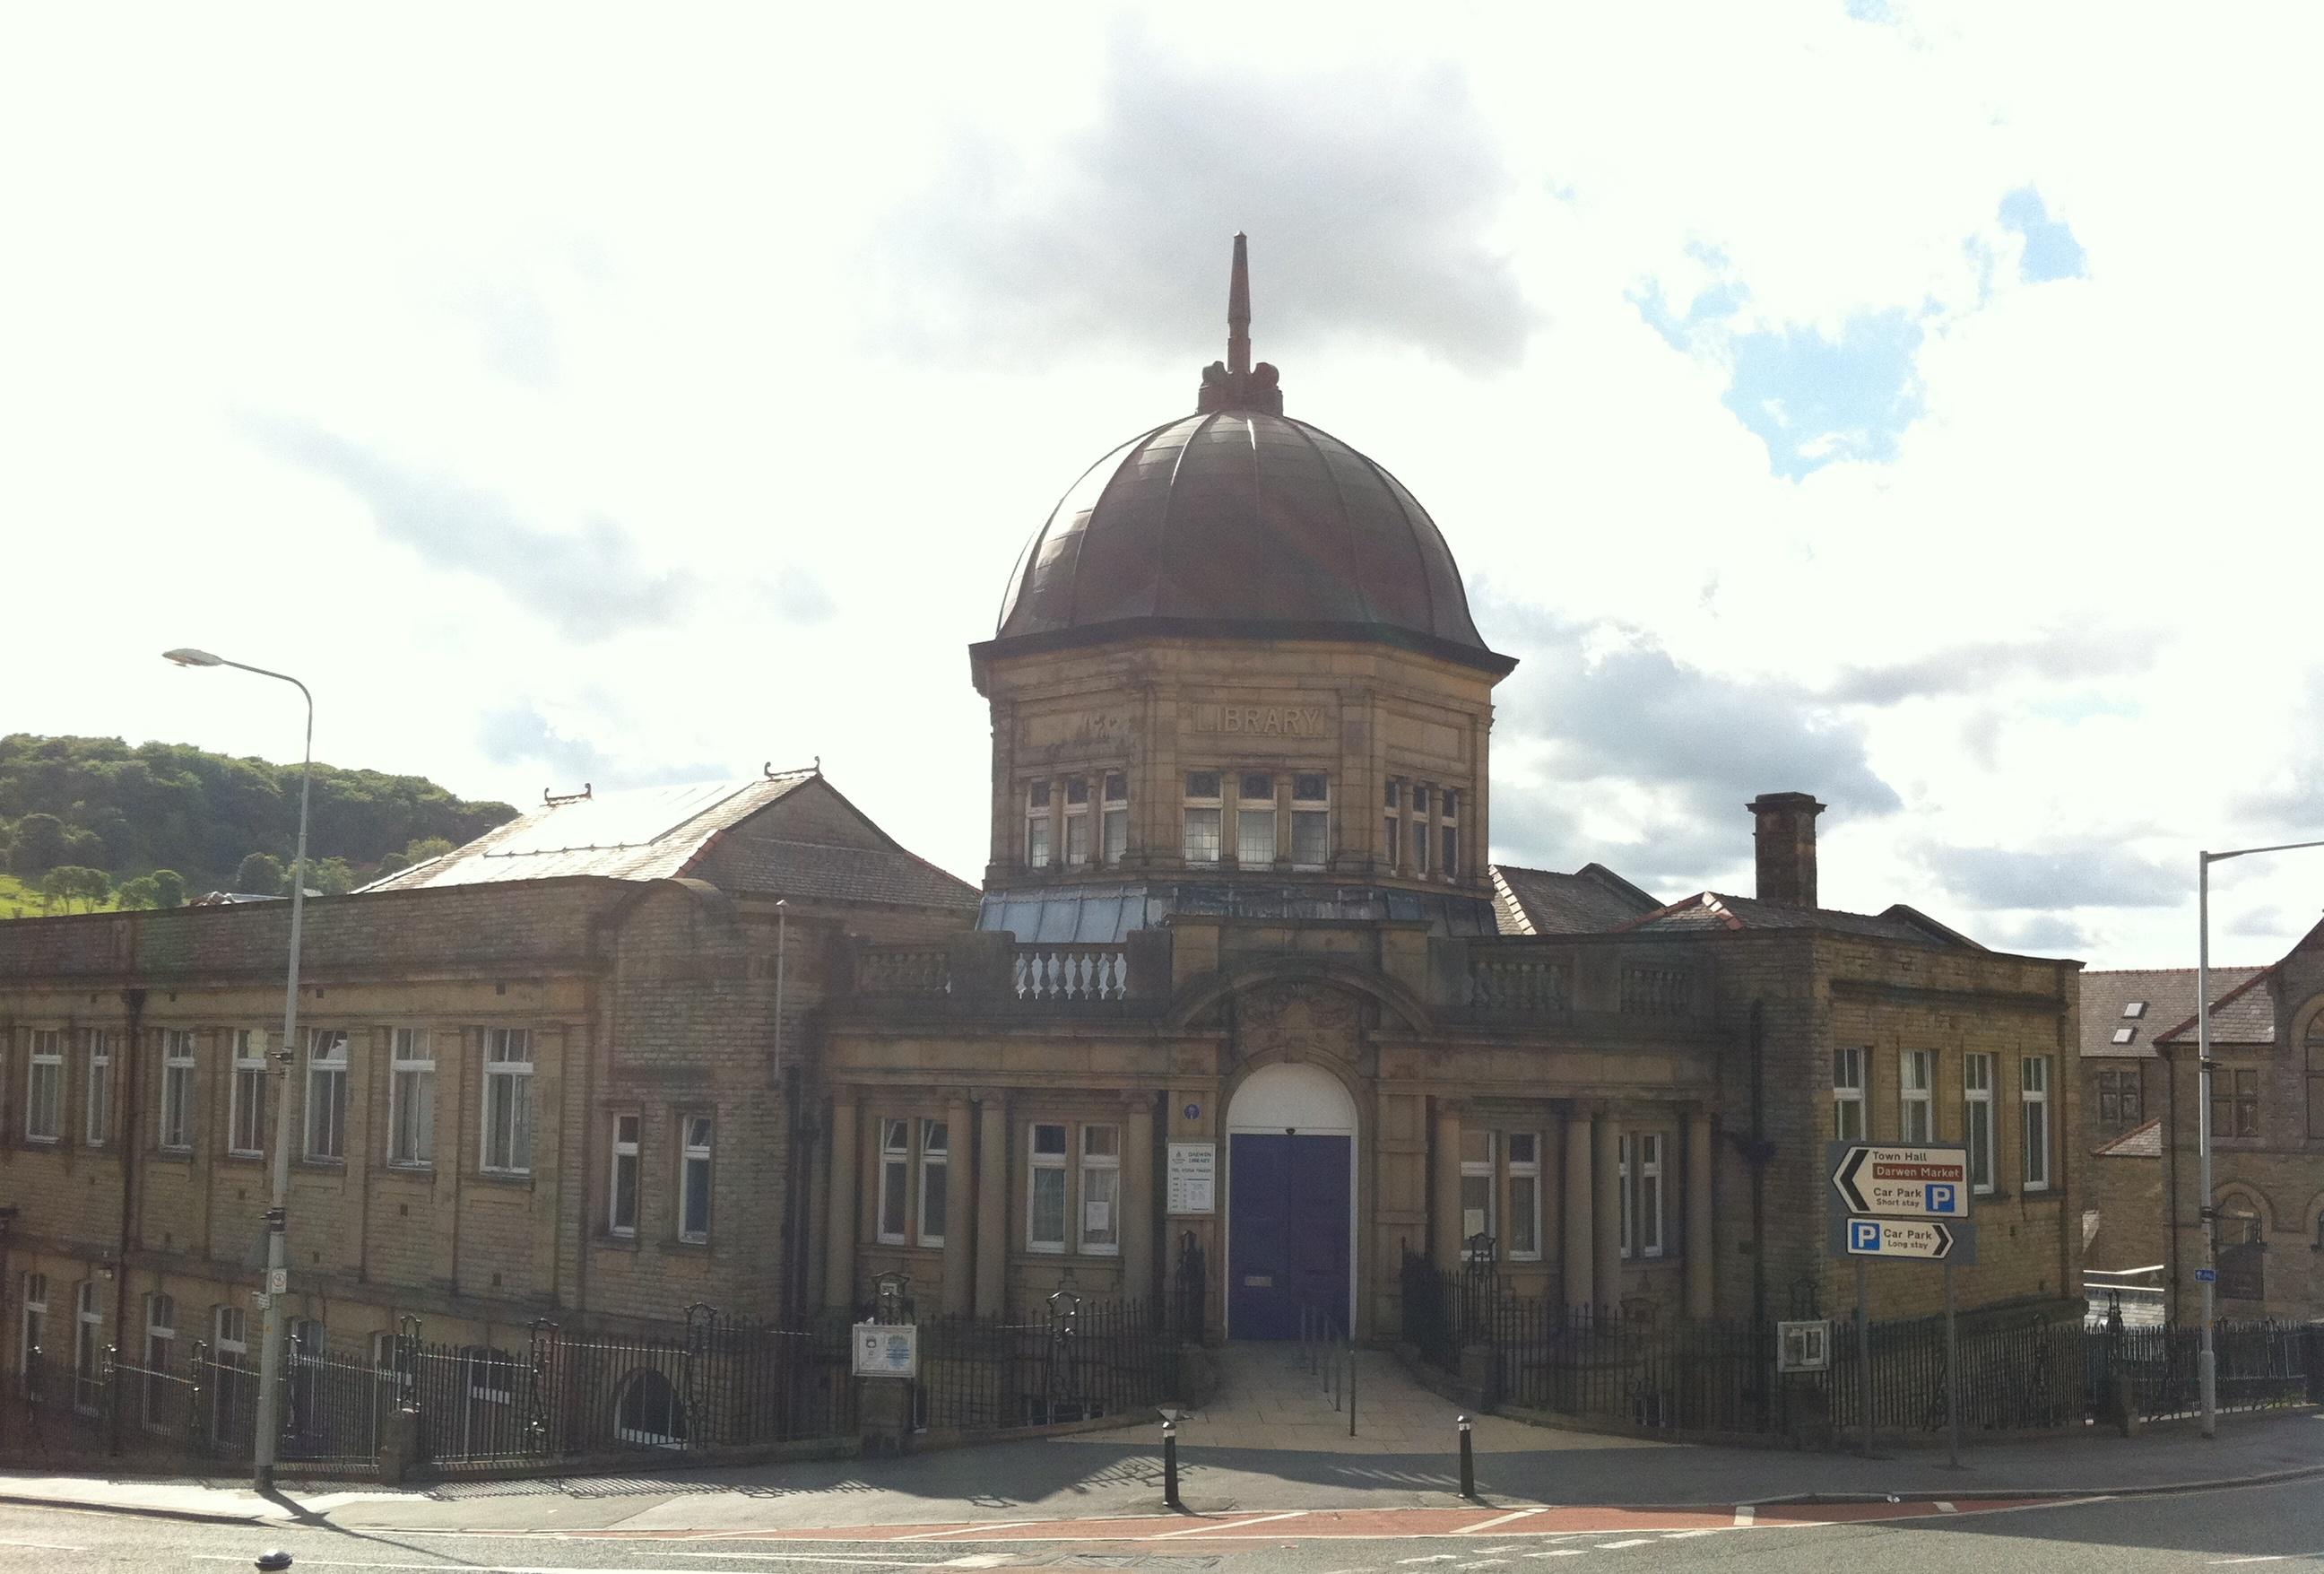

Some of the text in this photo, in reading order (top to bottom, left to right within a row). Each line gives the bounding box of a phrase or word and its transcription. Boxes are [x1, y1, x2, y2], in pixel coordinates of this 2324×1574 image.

[1197, 704, 1320, 735] LIBRARY
[1873, 1152, 1927, 1161] Town Hall
[1877, 1168, 1960, 1178] Darwen Market
[1874, 1187, 1921, 1198] Car Park
[1876, 1198, 1920, 1208] Short stay
[1932, 1187, 1951, 1210] P
[1858, 1225, 1876, 1248] P
[1884, 1229, 1932, 1239] Car Park
[1887, 1239, 1929, 1249] Long stay
